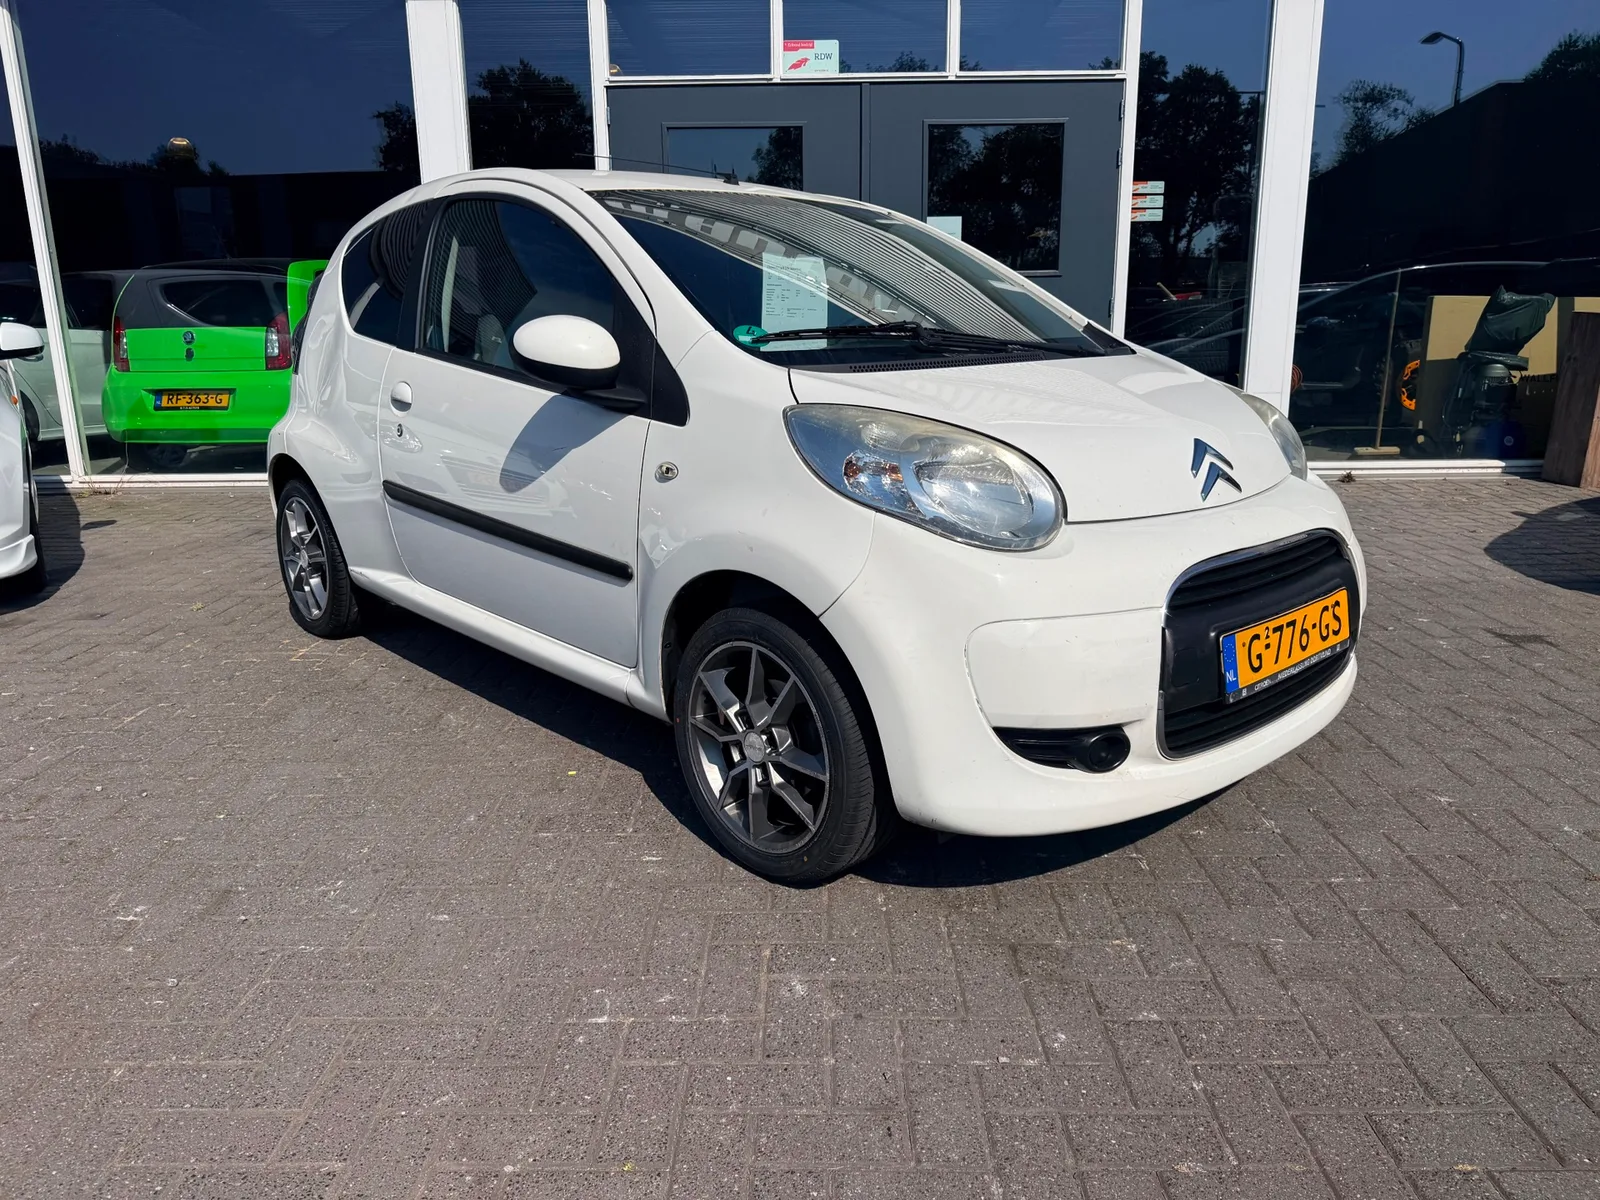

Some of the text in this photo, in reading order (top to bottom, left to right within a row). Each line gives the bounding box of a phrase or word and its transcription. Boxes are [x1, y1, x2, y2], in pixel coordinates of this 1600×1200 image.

[166, 392, 223, 405] RF-363-G
[1247, 600, 1342, 674] G-776-GS
[1225, 669, 1237, 684] NL
